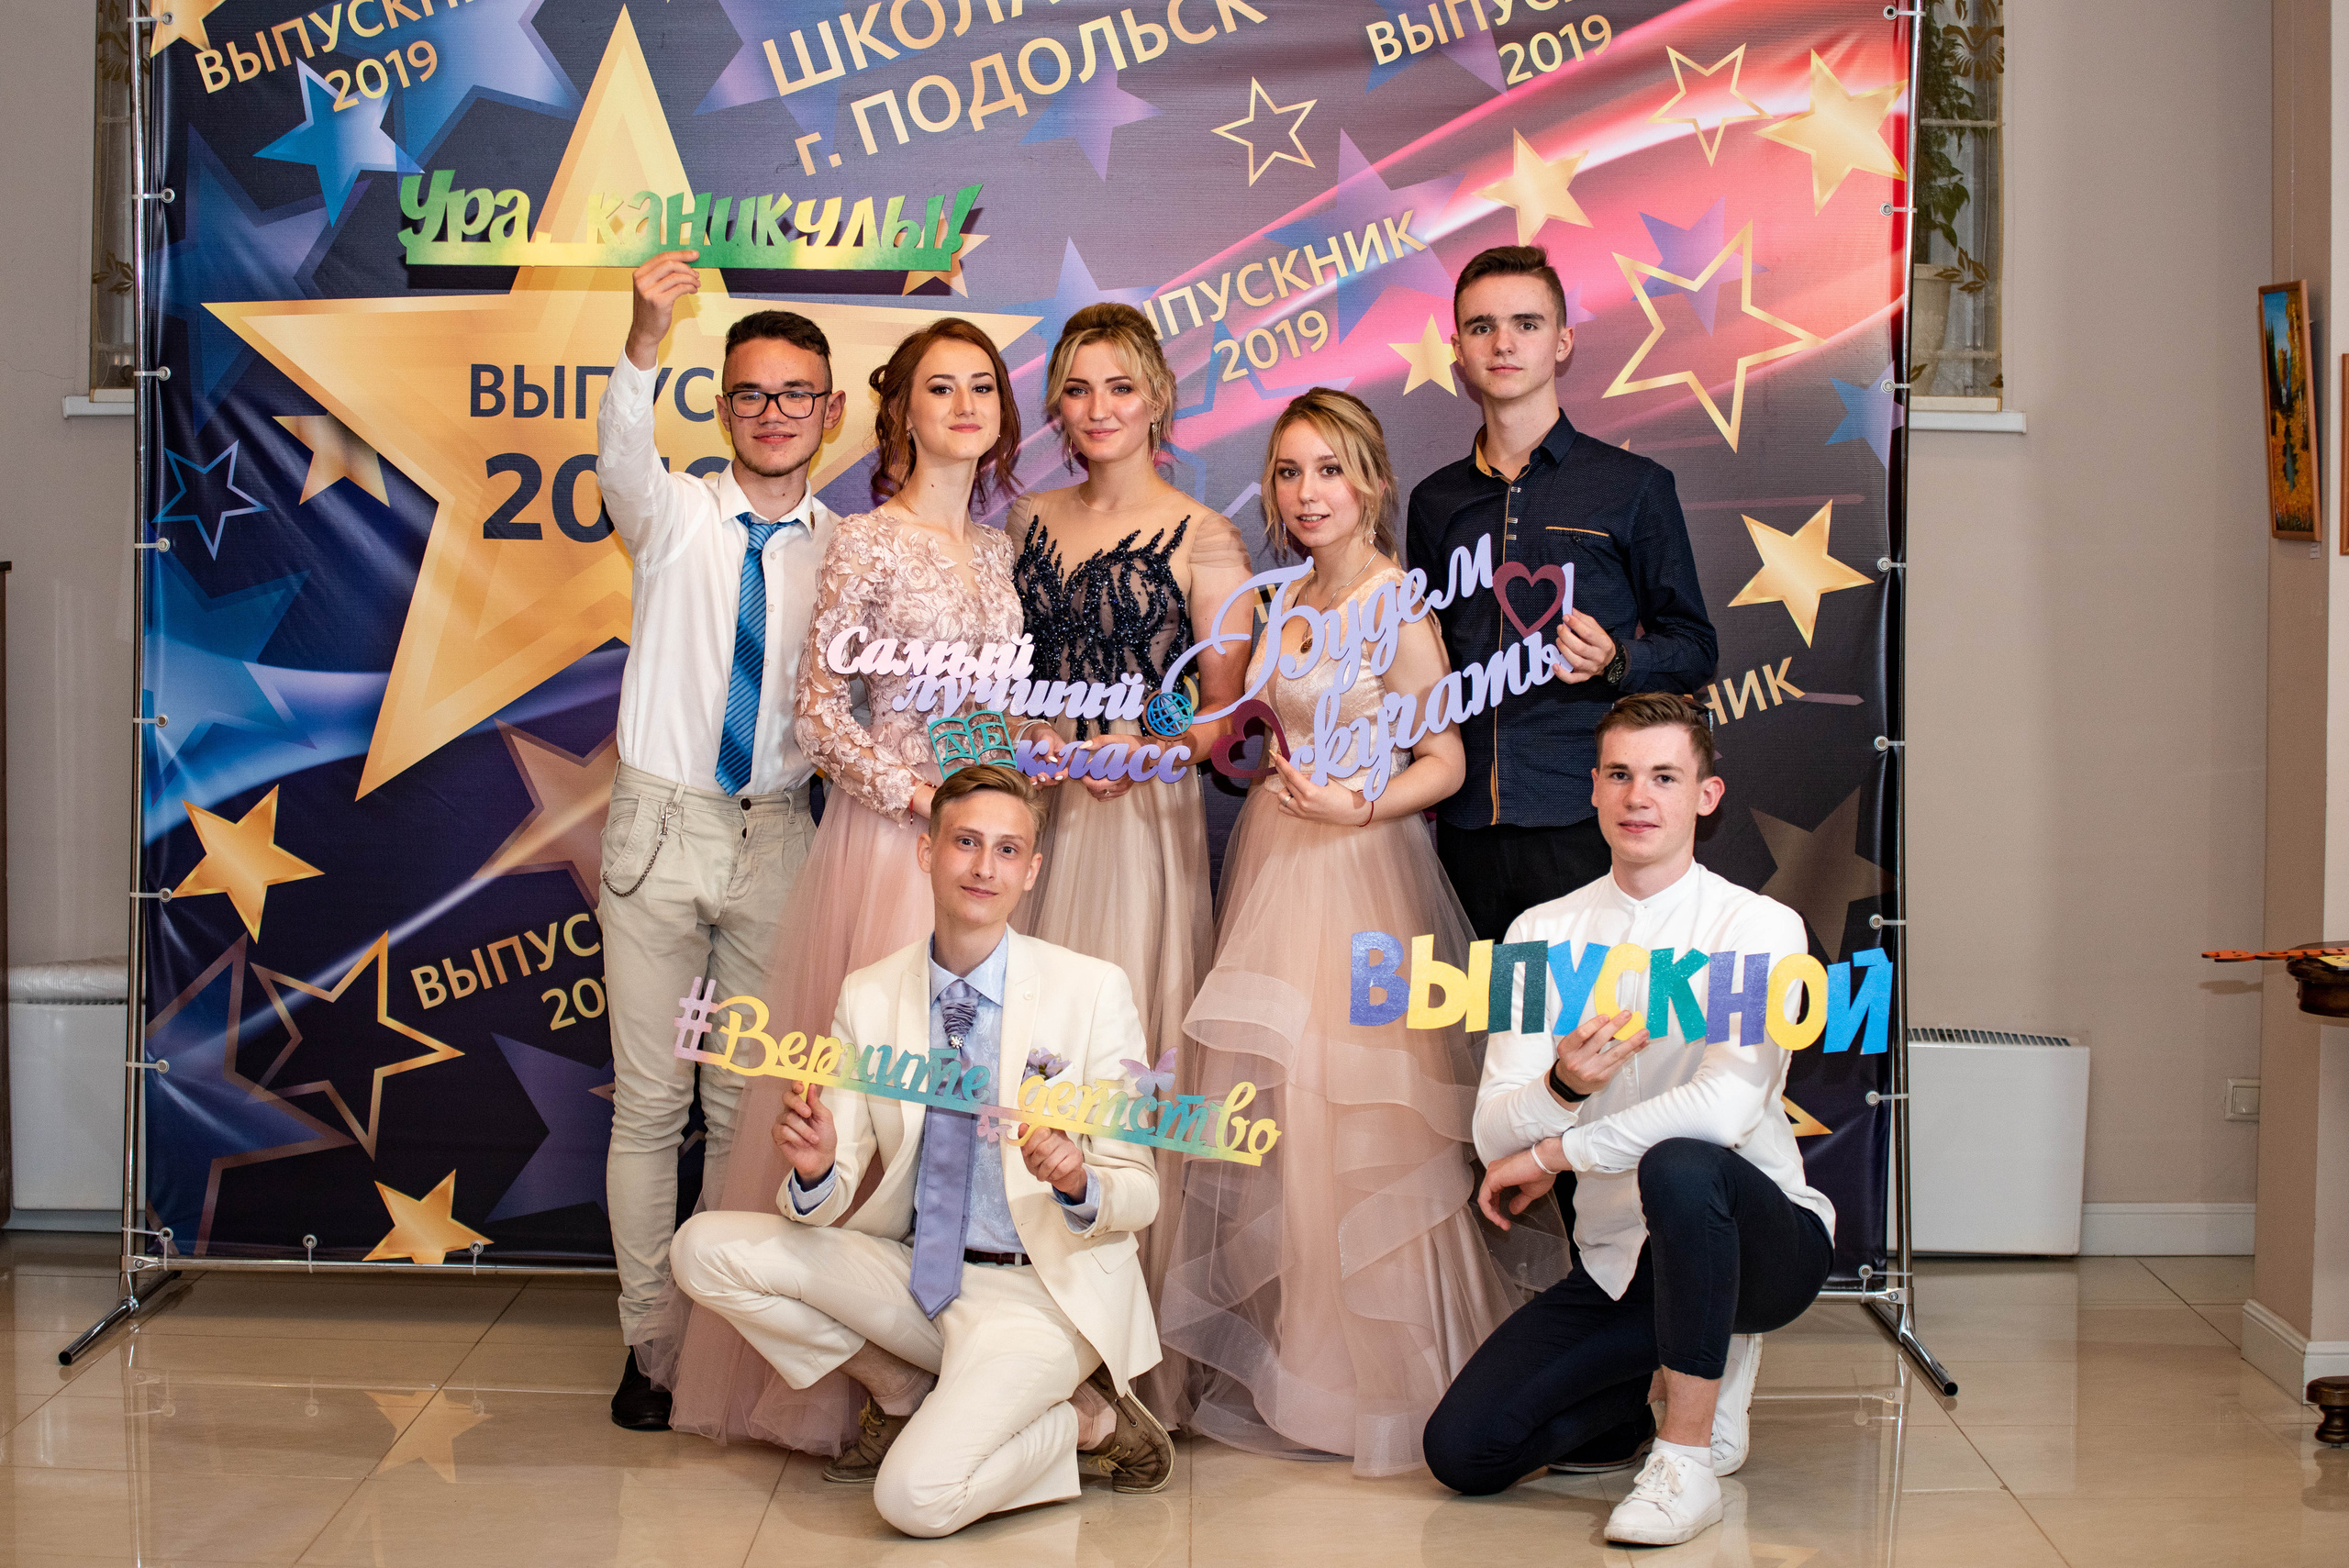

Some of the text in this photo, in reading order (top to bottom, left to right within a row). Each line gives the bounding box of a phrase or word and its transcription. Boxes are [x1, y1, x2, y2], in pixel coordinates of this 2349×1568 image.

[195, 0, 474, 94] ВЫПУСК
[324, 40, 438, 112] 2019
[763, 0, 1060, 96] ШКОЛ
[1497, 15, 1612, 85] 2019
[795, 0, 1268, 175] г. ПОДОЛЬСК
[587, 183, 984, 252] каникулы!
[1213, 310, 1329, 383] 2019
[483, 452, 731, 543] 20
[827, 626, 1035, 683] Самый
[1163, 533, 1493, 724] Будем
[892, 673, 1144, 728] лучший
[1015, 739, 1192, 784] класс
[410, 908, 602, 1010] ВЫПУС
[1350, 930, 1894, 1056] ВЫПУСКНОЙ
[540, 975, 607, 1031] 20
[1013, 1073, 1283, 1157] детство
